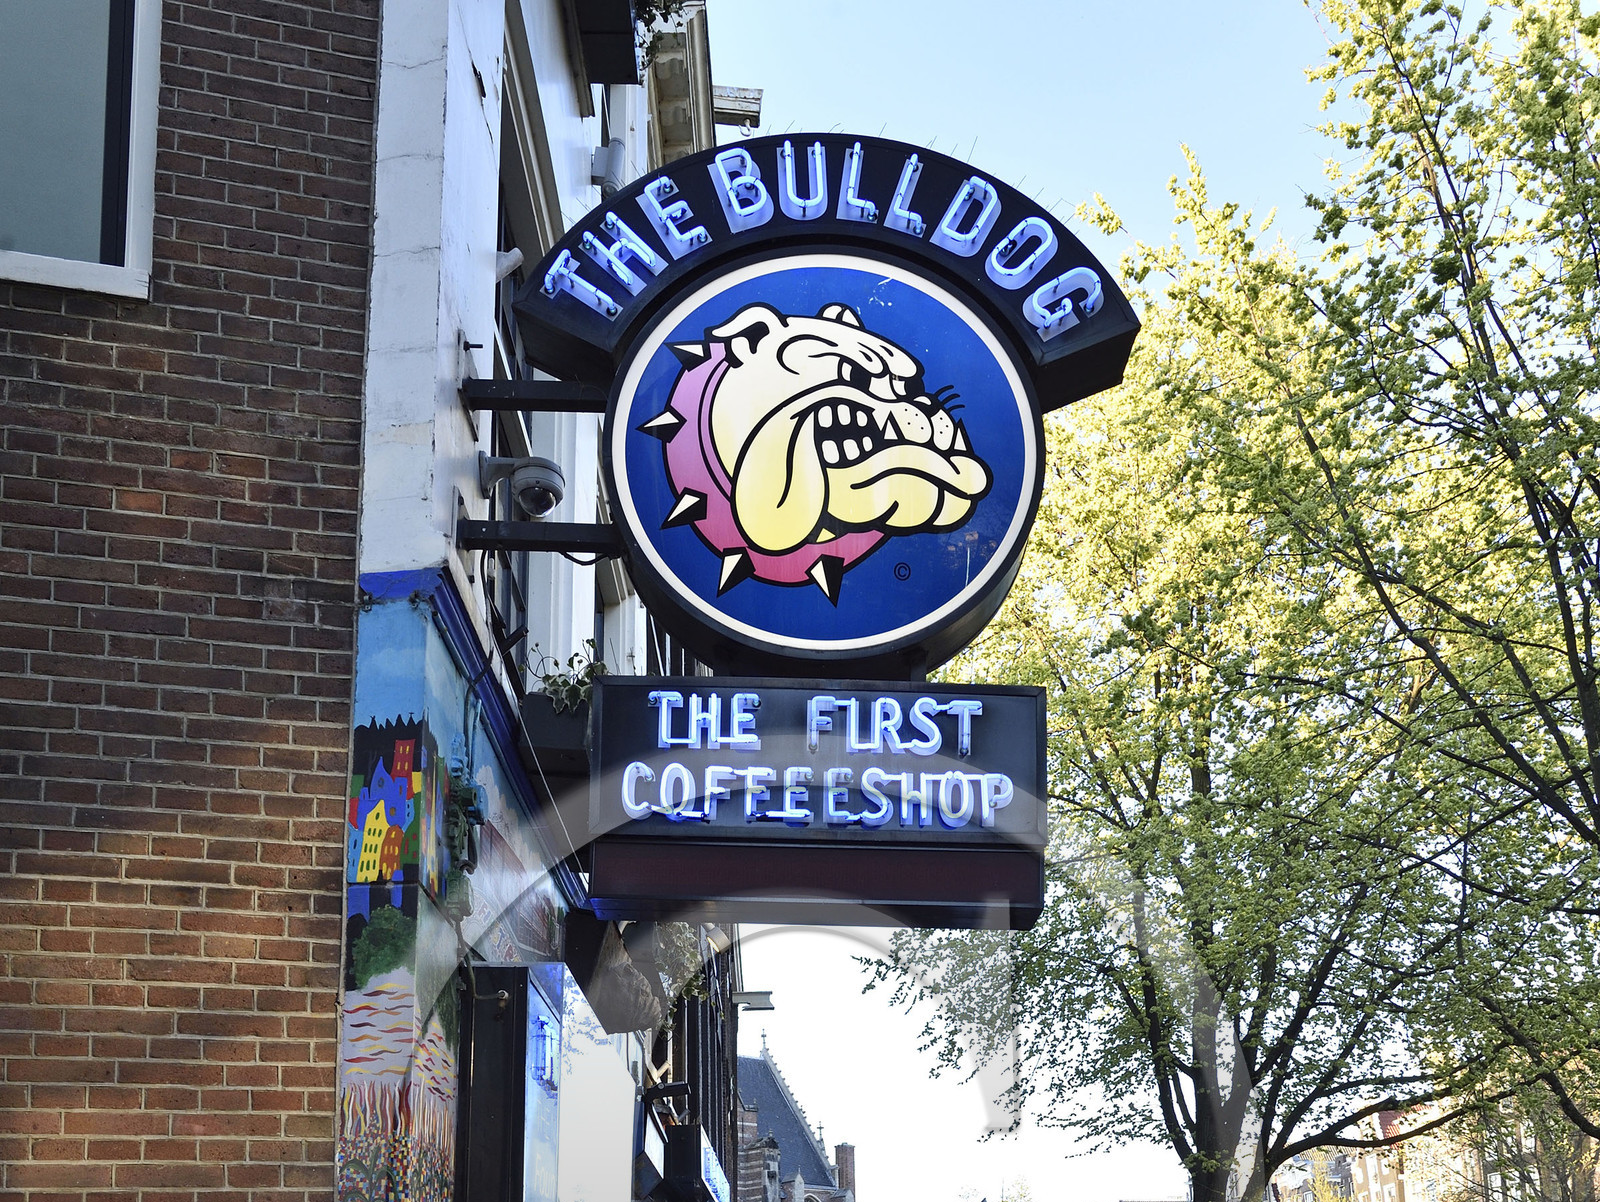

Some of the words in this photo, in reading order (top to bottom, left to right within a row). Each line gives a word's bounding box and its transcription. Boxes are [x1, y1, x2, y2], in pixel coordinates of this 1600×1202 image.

[540, 173, 711, 322] THE
[707, 140, 1104, 341] BULLDOG
[647, 690, 762, 750] THE
[807, 695, 984, 757] FIRST
[622, 761, 1014, 829] COFFEESHOP
